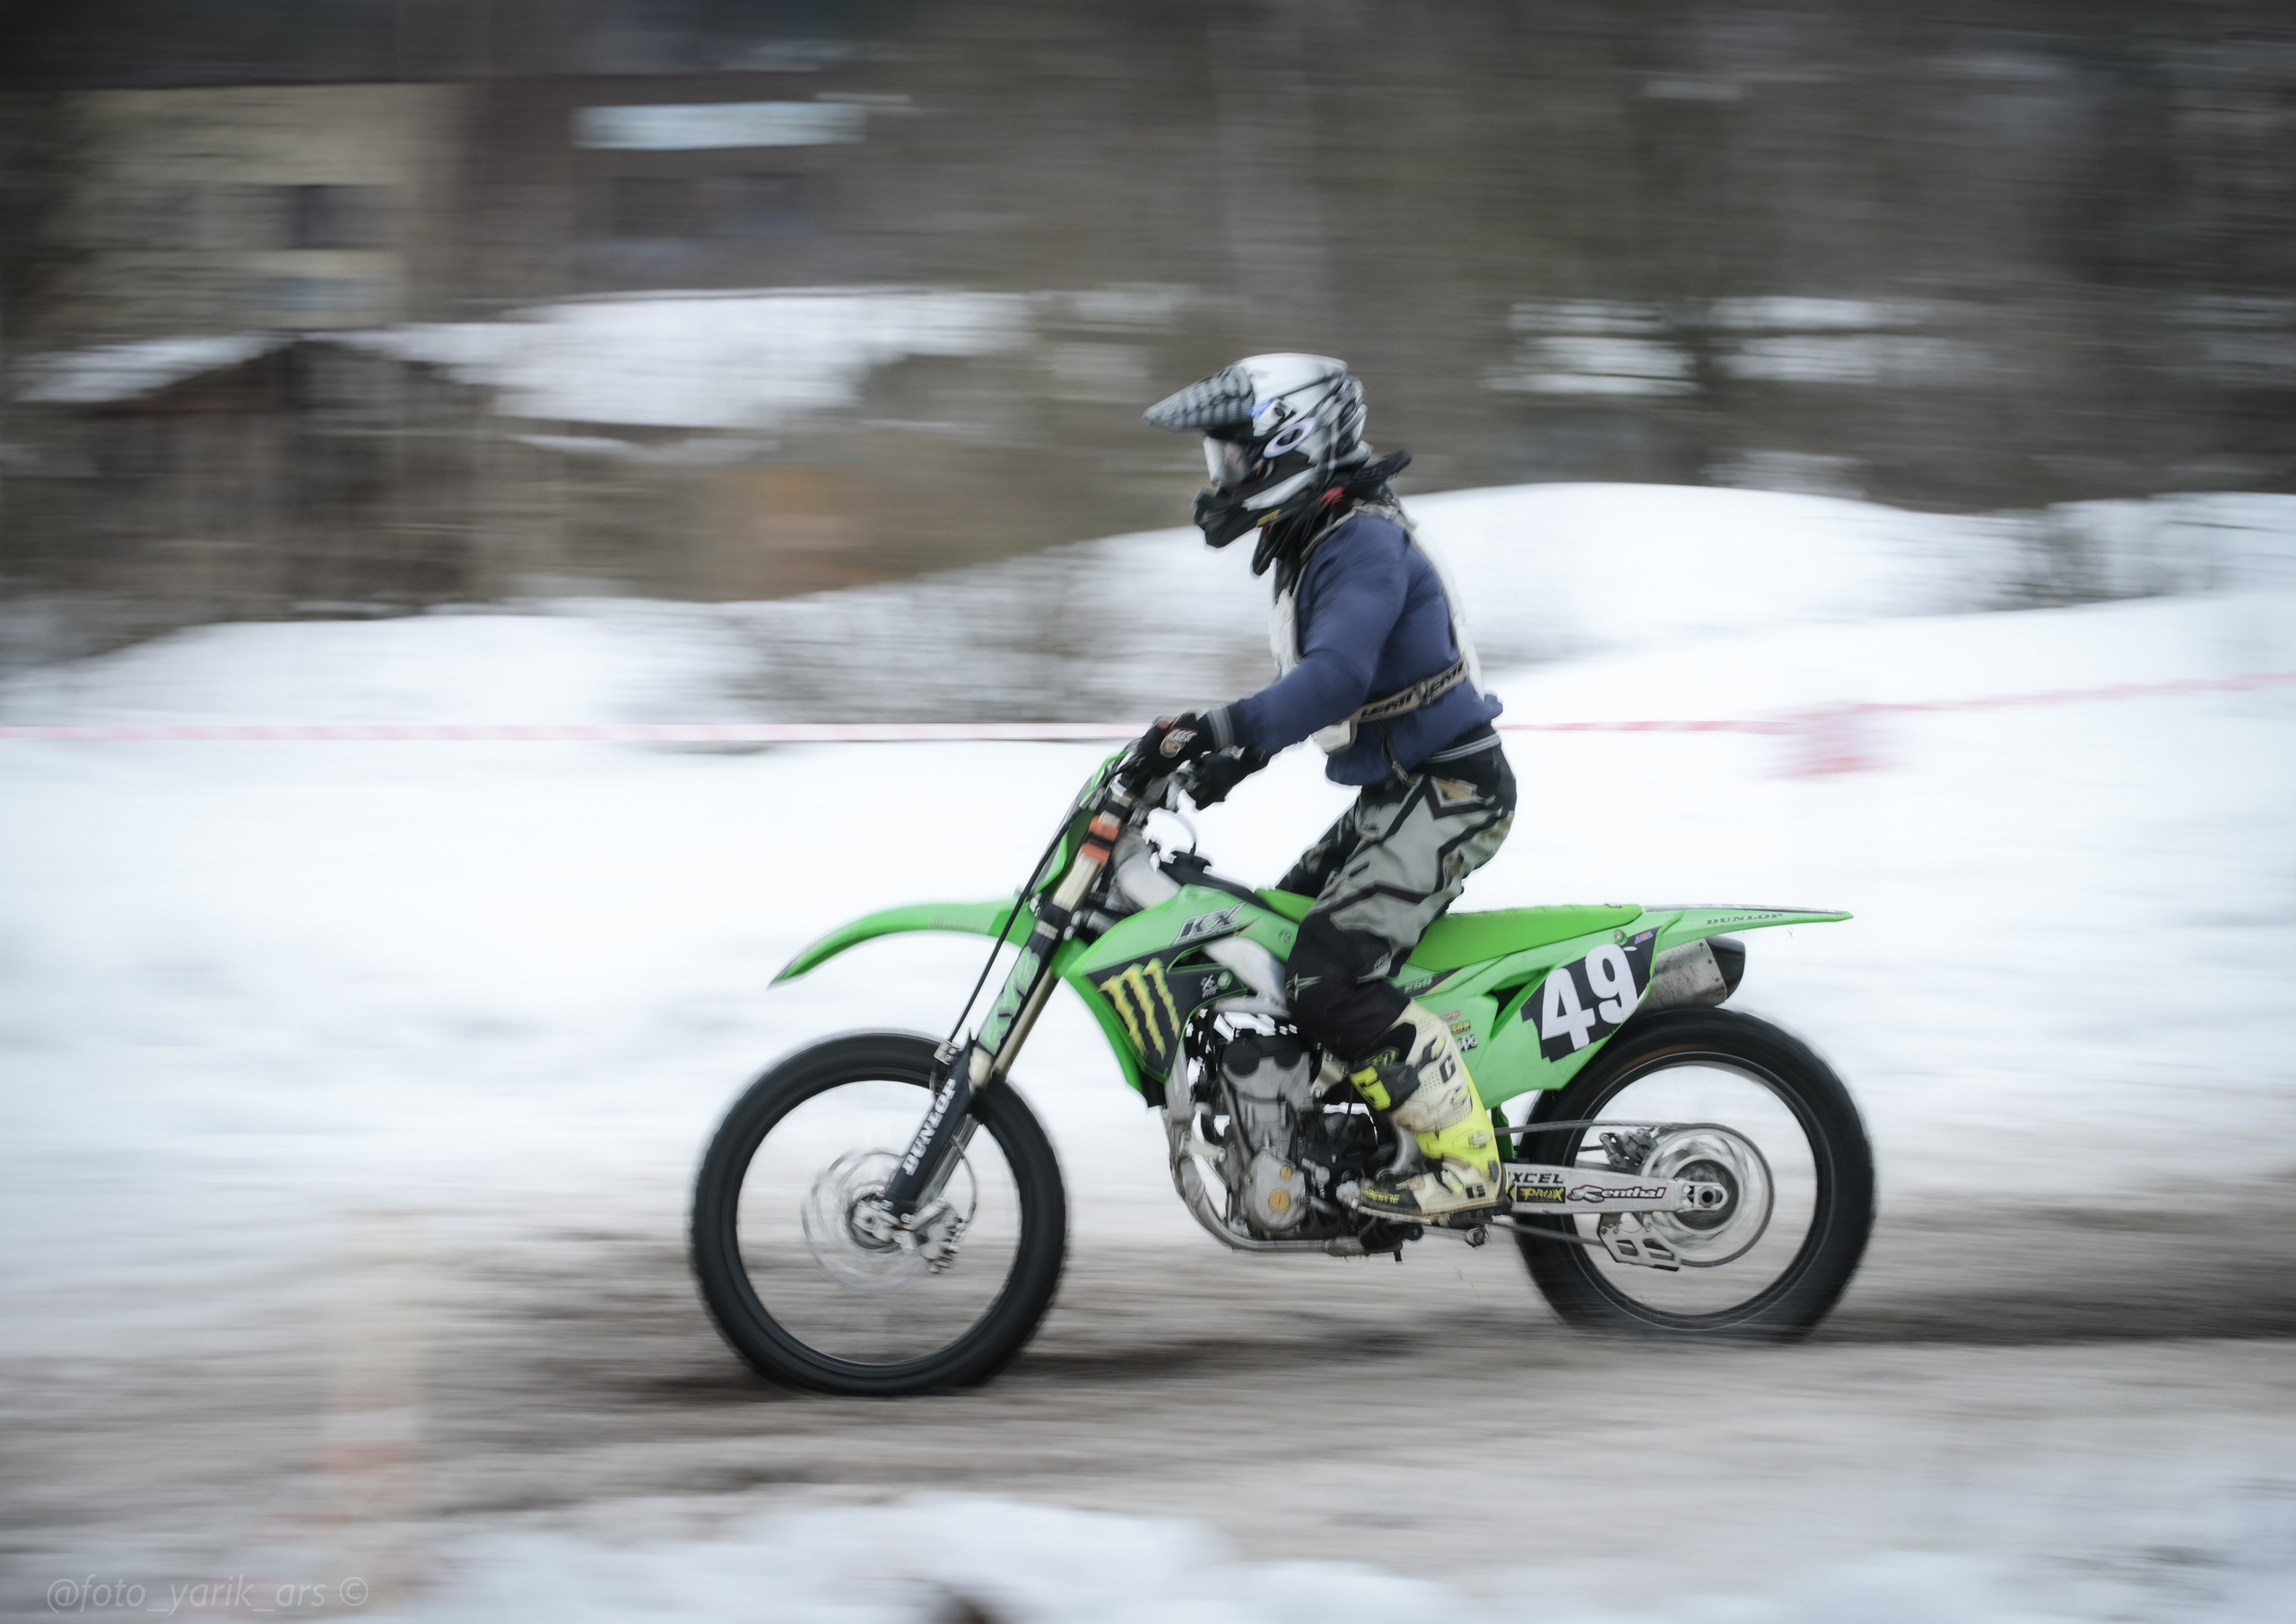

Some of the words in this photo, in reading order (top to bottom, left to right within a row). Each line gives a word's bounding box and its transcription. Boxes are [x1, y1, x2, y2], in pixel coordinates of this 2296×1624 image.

[1171, 901, 1248, 945] KX
[1706, 913, 1783, 925] DUNLOP
[978, 946, 1040, 1055] KYB
[1541, 942, 1639, 1051] 49
[904, 1078, 957, 1176] DUNLOP
[1569, 1184, 1666, 1203] Renthal
